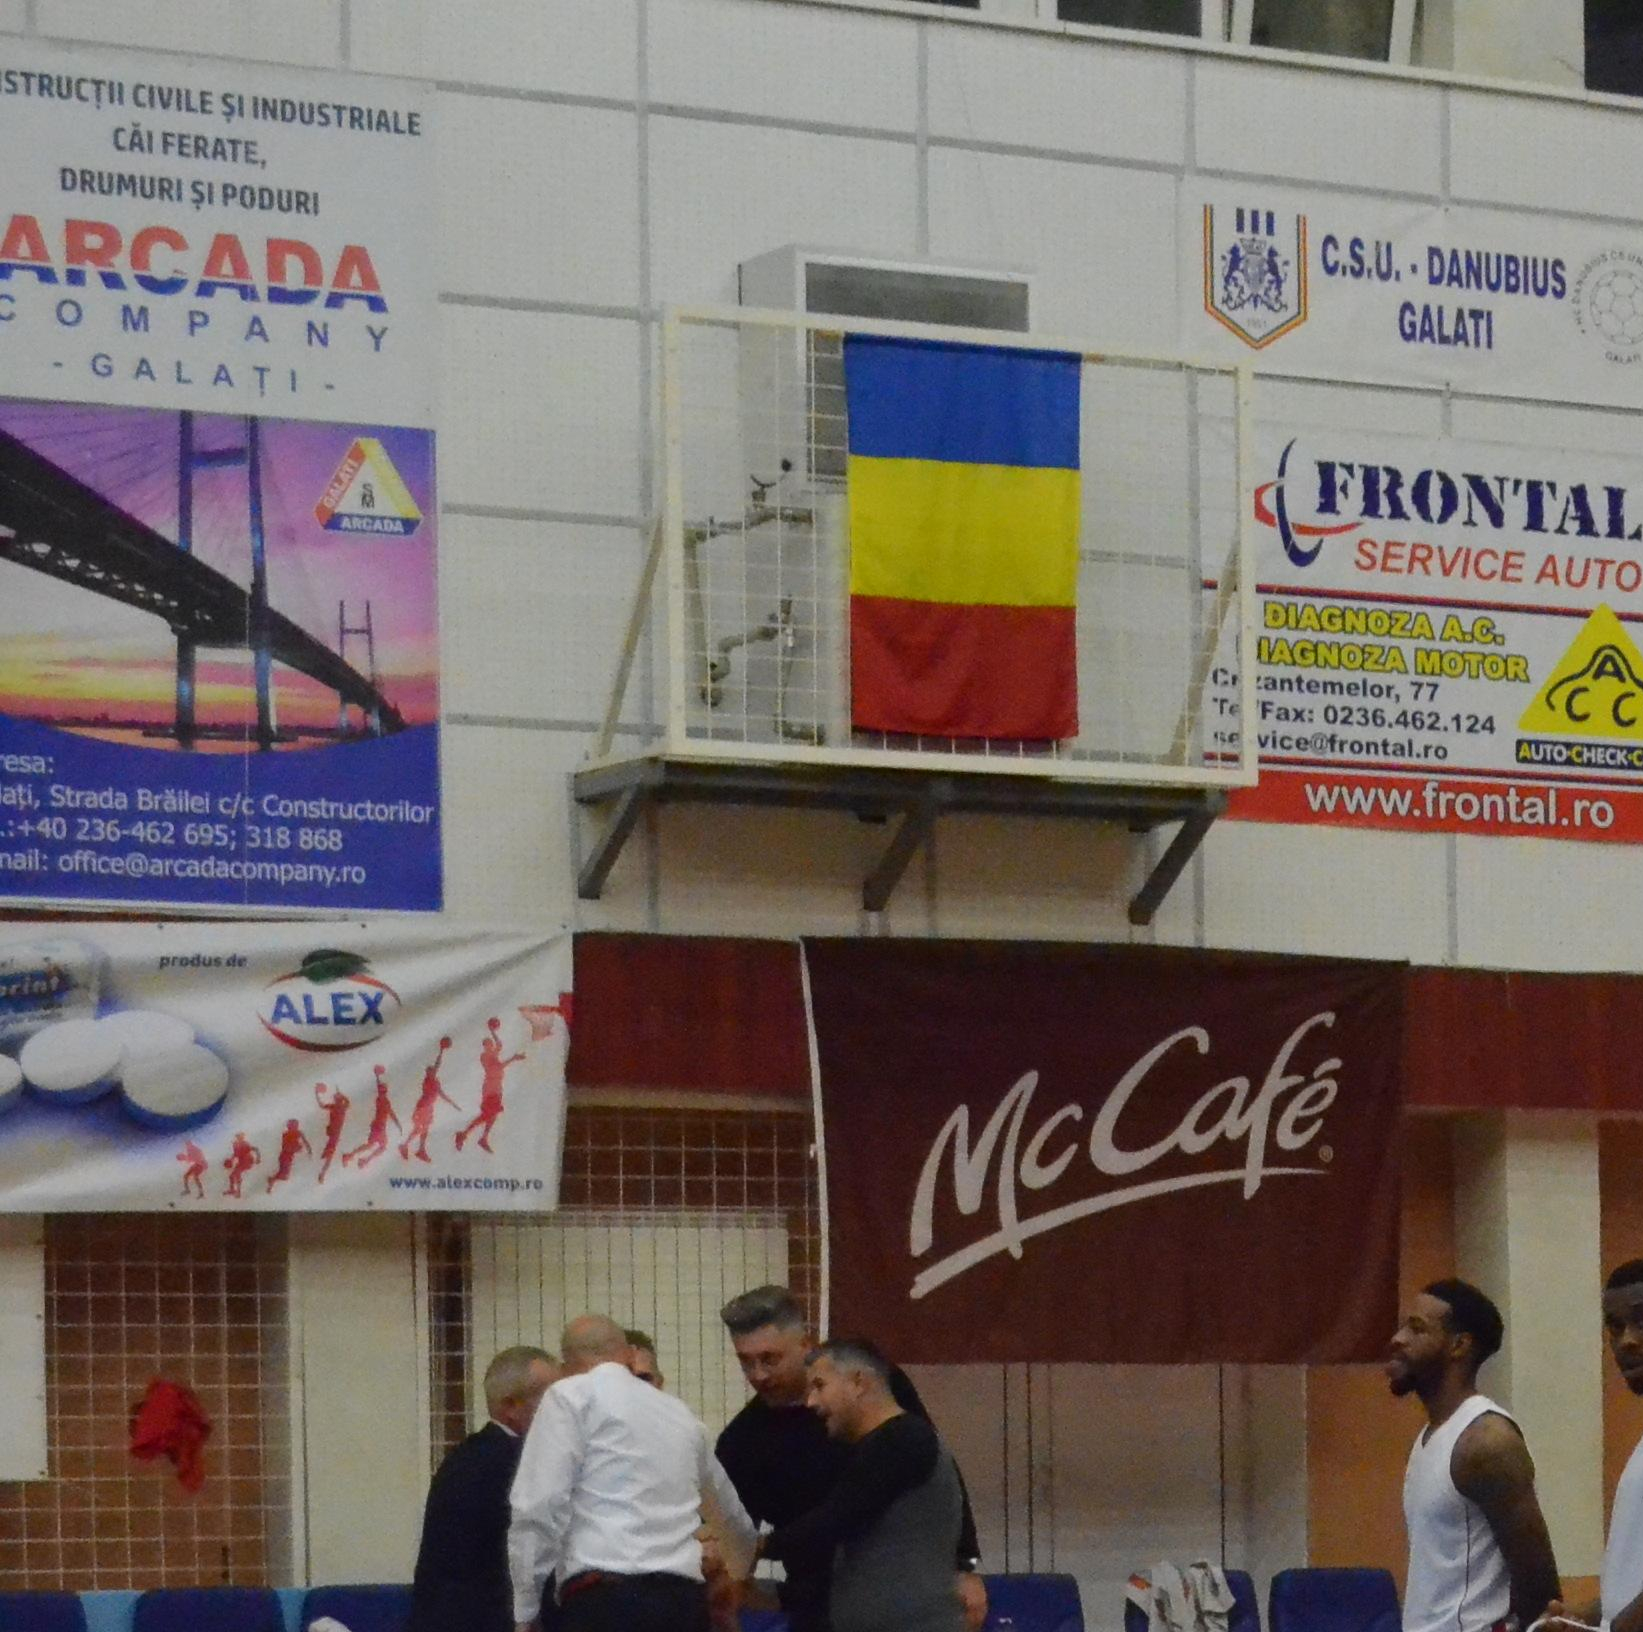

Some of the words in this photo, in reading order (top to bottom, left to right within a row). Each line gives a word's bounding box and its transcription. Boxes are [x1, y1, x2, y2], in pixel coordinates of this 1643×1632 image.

[0, 70, 125, 110] STRUCȚII
[133, 82, 213, 115] CIVILE
[252, 97, 421, 136] INDUSTRIALE
[113, 122, 154, 154] CĂI
[162, 132, 267, 169] FERATE,
[60, 167, 183, 202] DRUMURI
[223, 184, 320, 216] PODURI
[0, 214, 389, 313] ARCADA
[1321, 235, 1401, 282] C.S.U.
[1427, 245, 1567, 300] DANUBIUS
[1399, 301, 1494, 350] GALATI
[1315, 459, 1643, 542] FRONTAL
[1354, 537, 1526, 583] SERVICE
[1535, 554, 1643, 593] AUTO
[1264, 602, 1436, 642] DIAGNOZA
[1441, 615, 1506, 646] A.C.
[1236, 636, 1408, 675] IAGNOZA
[1415, 649, 1531, 683] MOTOR
[1410, 682, 1440, 701] 77
[1323, 704, 1497, 735] 0236.462.124
[0, 754, 55, 774] esa:
[49, 783, 129, 811] Strada
[138, 788, 210, 813] Brăilei
[219, 791, 255, 818] c/c
[263, 794, 435, 824] Constructorilor
[1304, 780, 1616, 829] www.frontal.ro
[76, 819, 175, 845] 236-462
[184, 825, 237, 851] 695;
[247, 826, 290, 849] 318
[300, 828, 343, 852] 868
[58, 849, 367, 886] office@arcadacompany.ro
[159, 952, 222, 971] produs
[227, 952, 248, 968] de
[271, 990, 385, 1026] ALEX
[909, 1010, 1344, 1261] McCafé
[390, 1174, 544, 1193] www.alexcomp.ro
